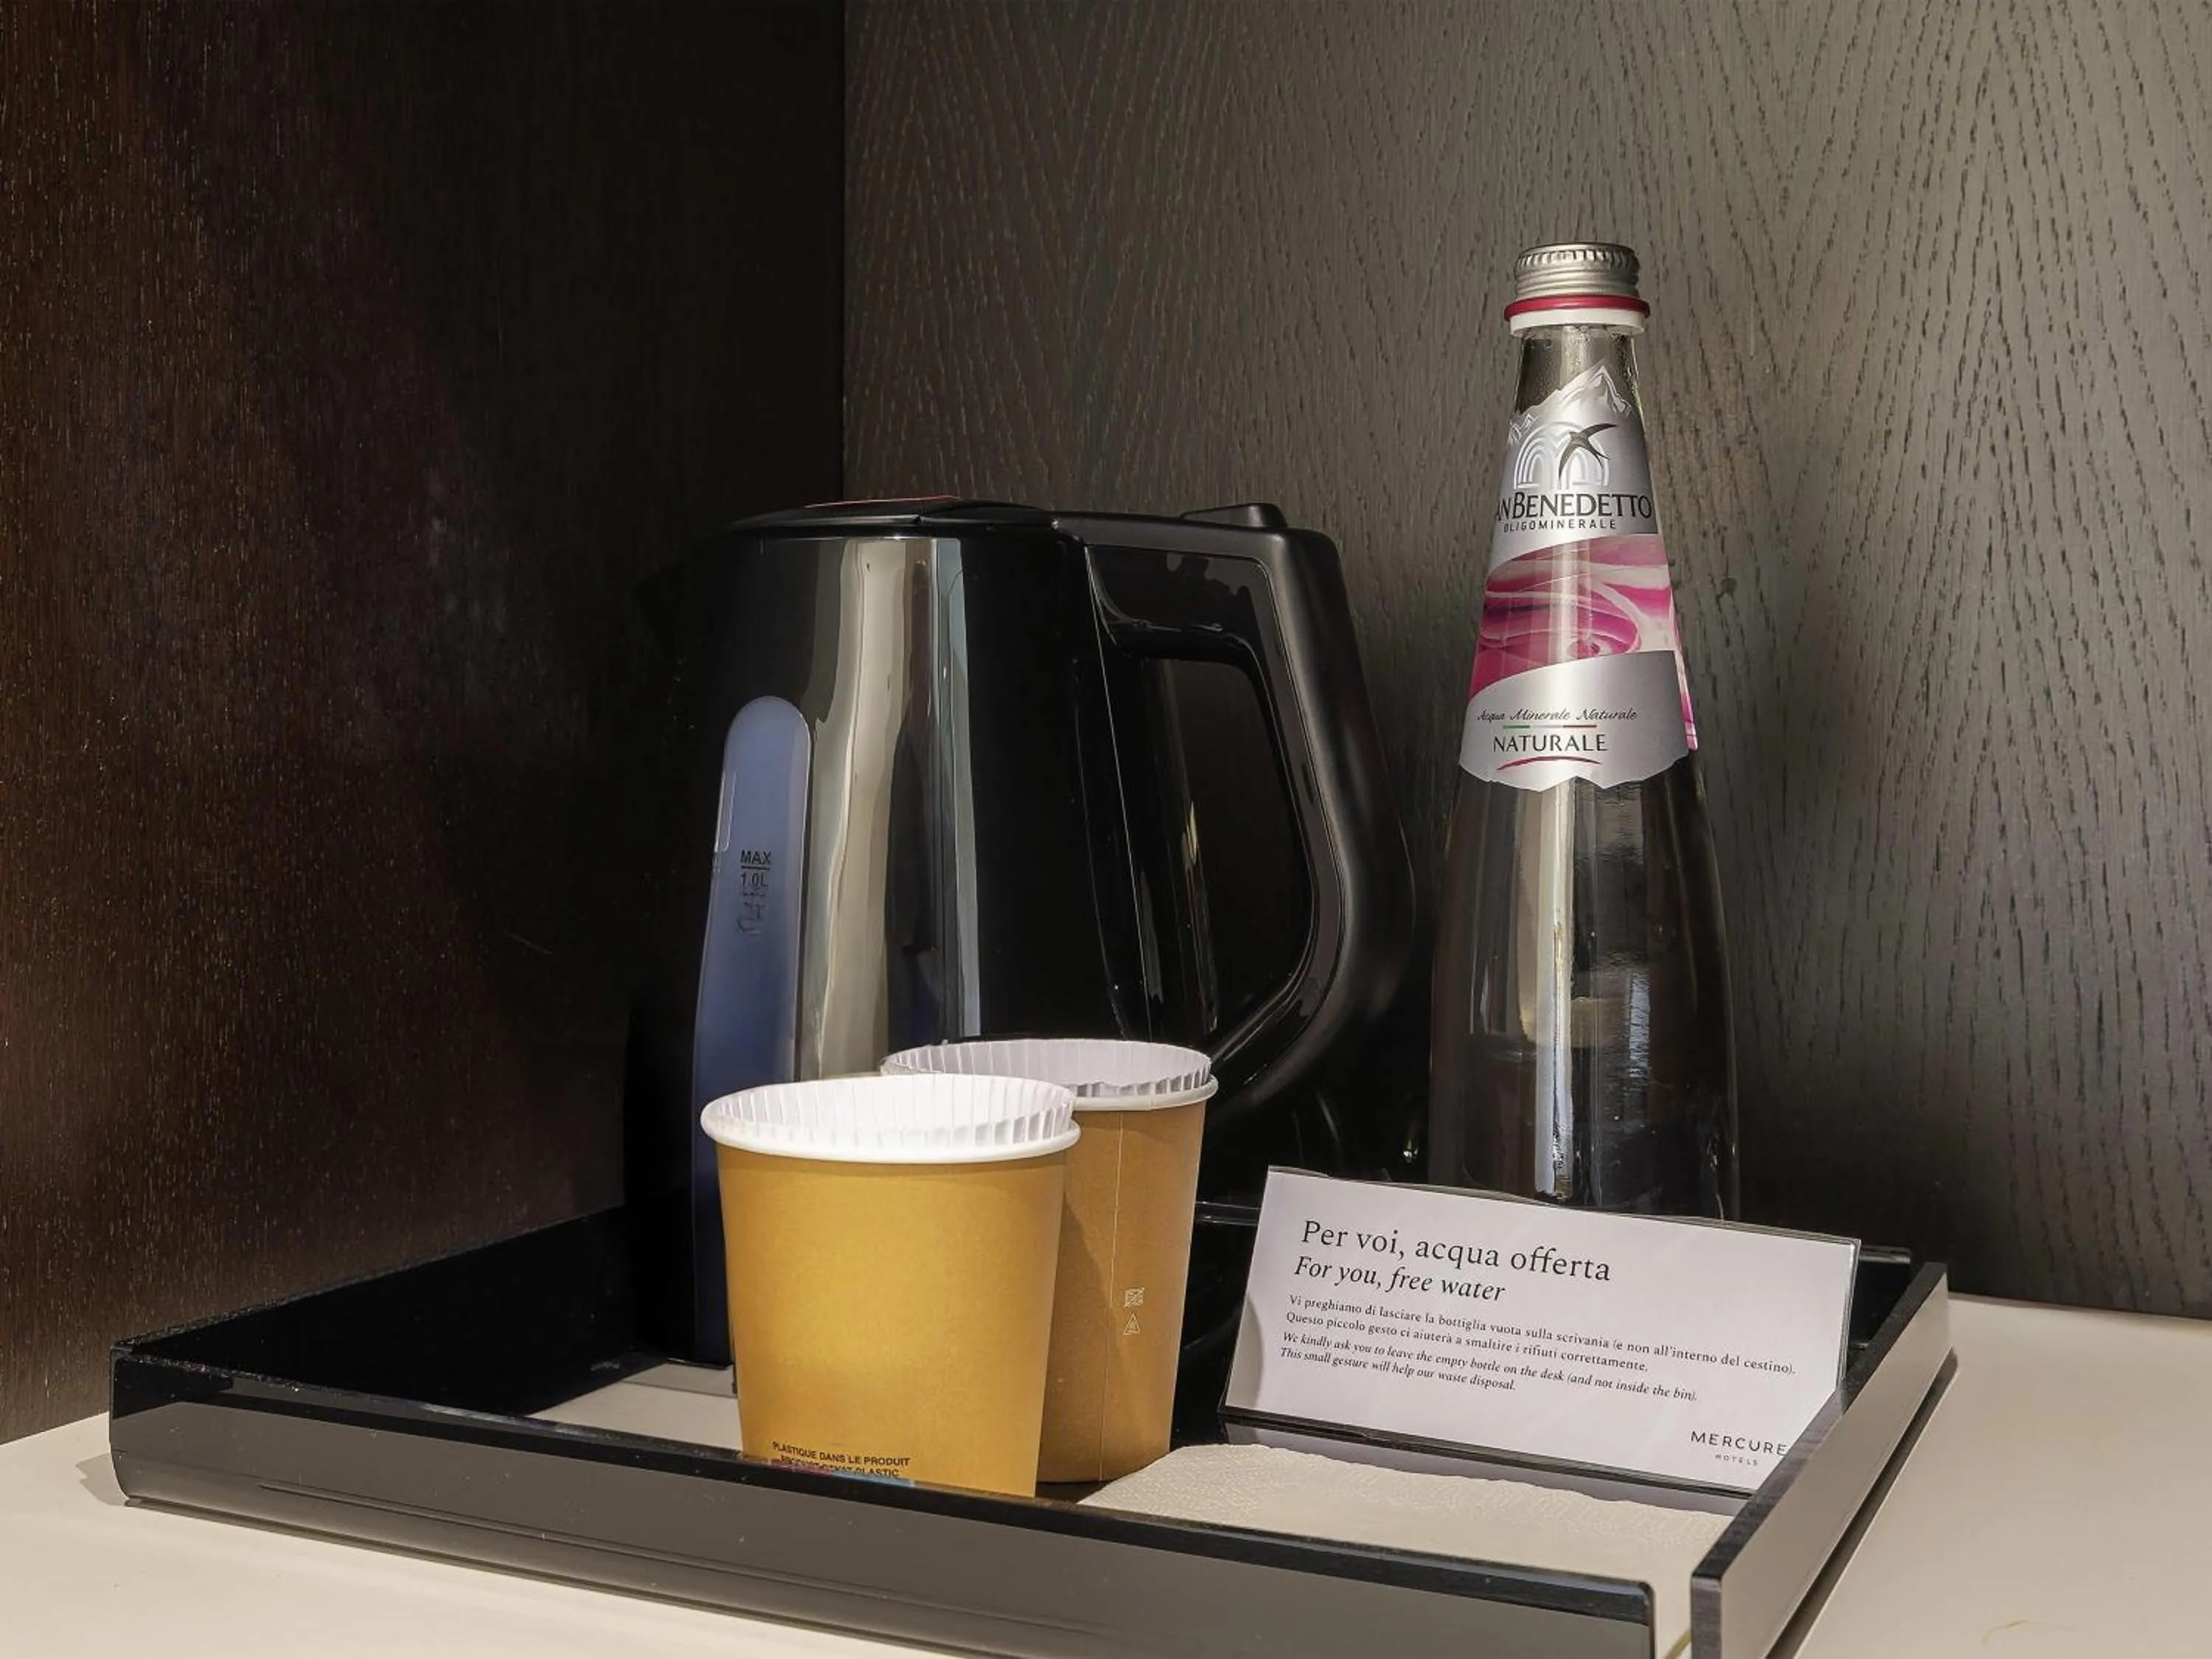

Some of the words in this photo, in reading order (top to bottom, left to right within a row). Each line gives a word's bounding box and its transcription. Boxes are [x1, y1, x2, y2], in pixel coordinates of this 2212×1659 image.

[1477, 709, 1506, 723] Acqua
[1510, 709, 1571, 720] Minerale
[1576, 708, 1638, 720] Naturale
[1492, 734, 1609, 753] NATURALE
[740, 849, 772, 864] MAX
[1301, 1220, 1348, 1247] Per
[1357, 1229, 1405, 1260] voi,
[1416, 1240, 1499, 1269] acqua
[1510, 1246, 1612, 1281] offerta
[1293, 1255, 1332, 1279] For
[1335, 1265, 1382, 1288] you,
[1385, 1267, 1433, 1293] free
[1441, 1277, 1506, 1301] water
[1287, 1312, 1324, 1326] Questo
[1327, 1318, 1365, 1332] piccolo
[1368, 1324, 1397, 1337] gesto
[1400, 1328, 1410, 1338] ci
[1413, 1330, 1452, 1344] aiuterà
[1455, 1337, 1462, 1345] a
[1465, 1337, 1512, 1352] smaltire
[1523, 1345, 1557, 1358] rifiuti
[1561, 1352, 1648, 1371] correttamente.
[1290, 1295, 1301, 1305] Vi
[1304, 1298, 1362, 1314] preghiamo
[1365, 1305, 1377, 1315] di
[1380, 1306, 1421, 1322] lasciare
[1425, 1312, 1435, 1324] la
[1439, 1315, 1486, 1331] bottiglia
[1490, 1324, 1522, 1335] vuota
[1525, 1326, 1551, 1340] sulla
[1557, 1333, 1609, 1348] scrivania
[1613, 1340, 1623, 1350] (e
[1627, 1343, 1649, 1354] non
[1721, 1354, 1739, 1366] del
[1744, 1359, 1795, 1374] cestino).
[1280, 1347, 1301, 1359] This
[1304, 1349, 1330, 1363] small
[1332, 1357, 1368, 1370] gesture
[1372, 1360, 1389, 1372] will
[1392, 1363, 1414, 1378] help
[1417, 1369, 1434, 1378] our
[1438, 1371, 1467, 1384] waste
[1470, 1373, 1516, 1391] disposal.
[1283, 1332, 1298, 1343] We
[1301, 1335, 1332, 1349] kindly
[1335, 1340, 1350, 1350] ask
[1353, 1343, 1371, 1355] you
[1374, 1346, 1384, 1354] to
[1387, 1346, 1413, 1359] leave
[1416, 1351, 1432, 1362] the
[1436, 1355, 1467, 1368] empty
[1470, 1357, 1500, 1371] bottle
[1504, 1366, 1516, 1374] on
[1520, 1366, 1537, 1377] the
[1540, 1369, 1564, 1381] desk
[1567, 1373, 1592, 1386] (and
[1594, 1378, 1612, 1389] not
[1615, 1380, 1649, 1394] inside
[1652, 1385, 1670, 1397] the
[1674, 1386, 1697, 1401] bin).
[772, 1441, 817, 1459] PLASTIQUE
[820, 1452, 846, 1463] DANS
[849, 1455, 861, 1464] LE
[863, 1457, 911, 1467] PRODUIT
[1691, 1430, 1789, 1455] MERCURE
[1716, 1454, 1758, 1466] HOTELS
